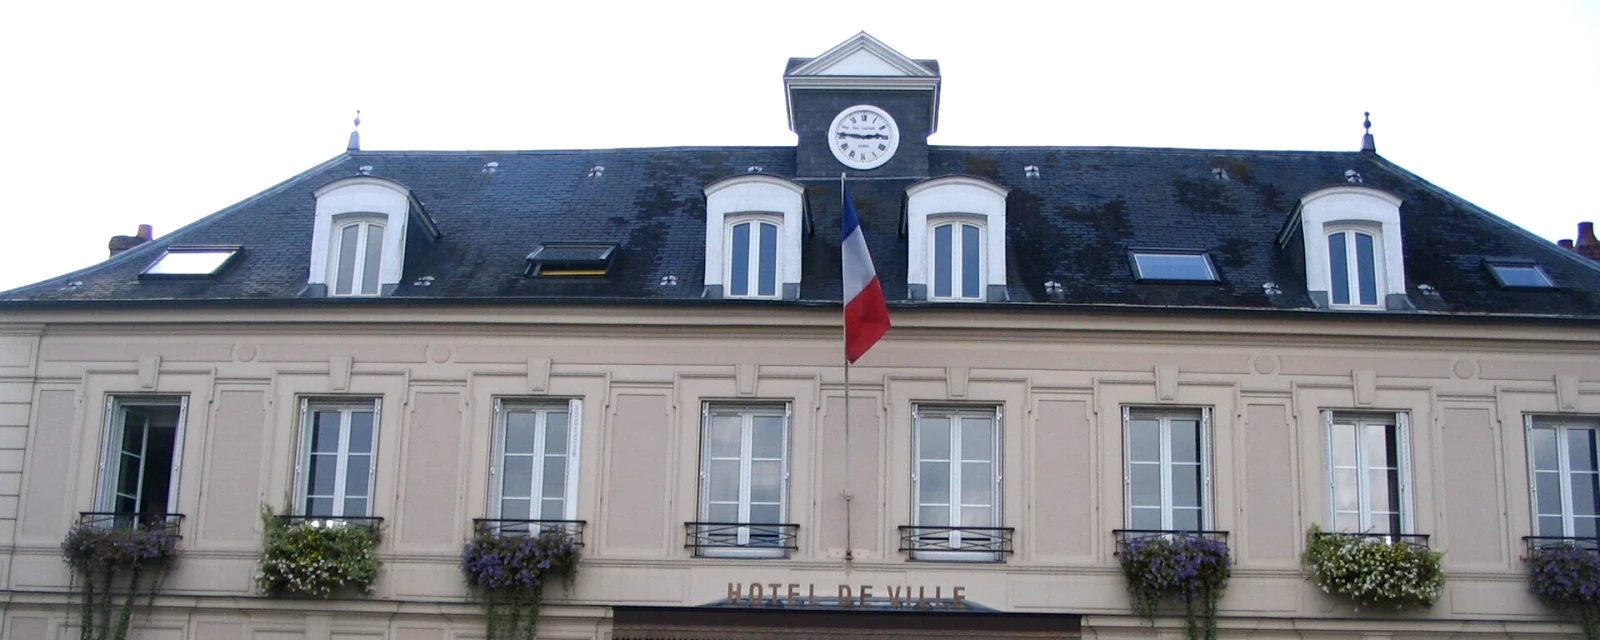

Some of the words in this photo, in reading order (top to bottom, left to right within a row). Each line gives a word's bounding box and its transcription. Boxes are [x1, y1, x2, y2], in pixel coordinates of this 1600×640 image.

[727, 582, 820, 606] HOTEL
[838, 584, 873, 608] DE
[887, 585, 966, 609] VILLE
